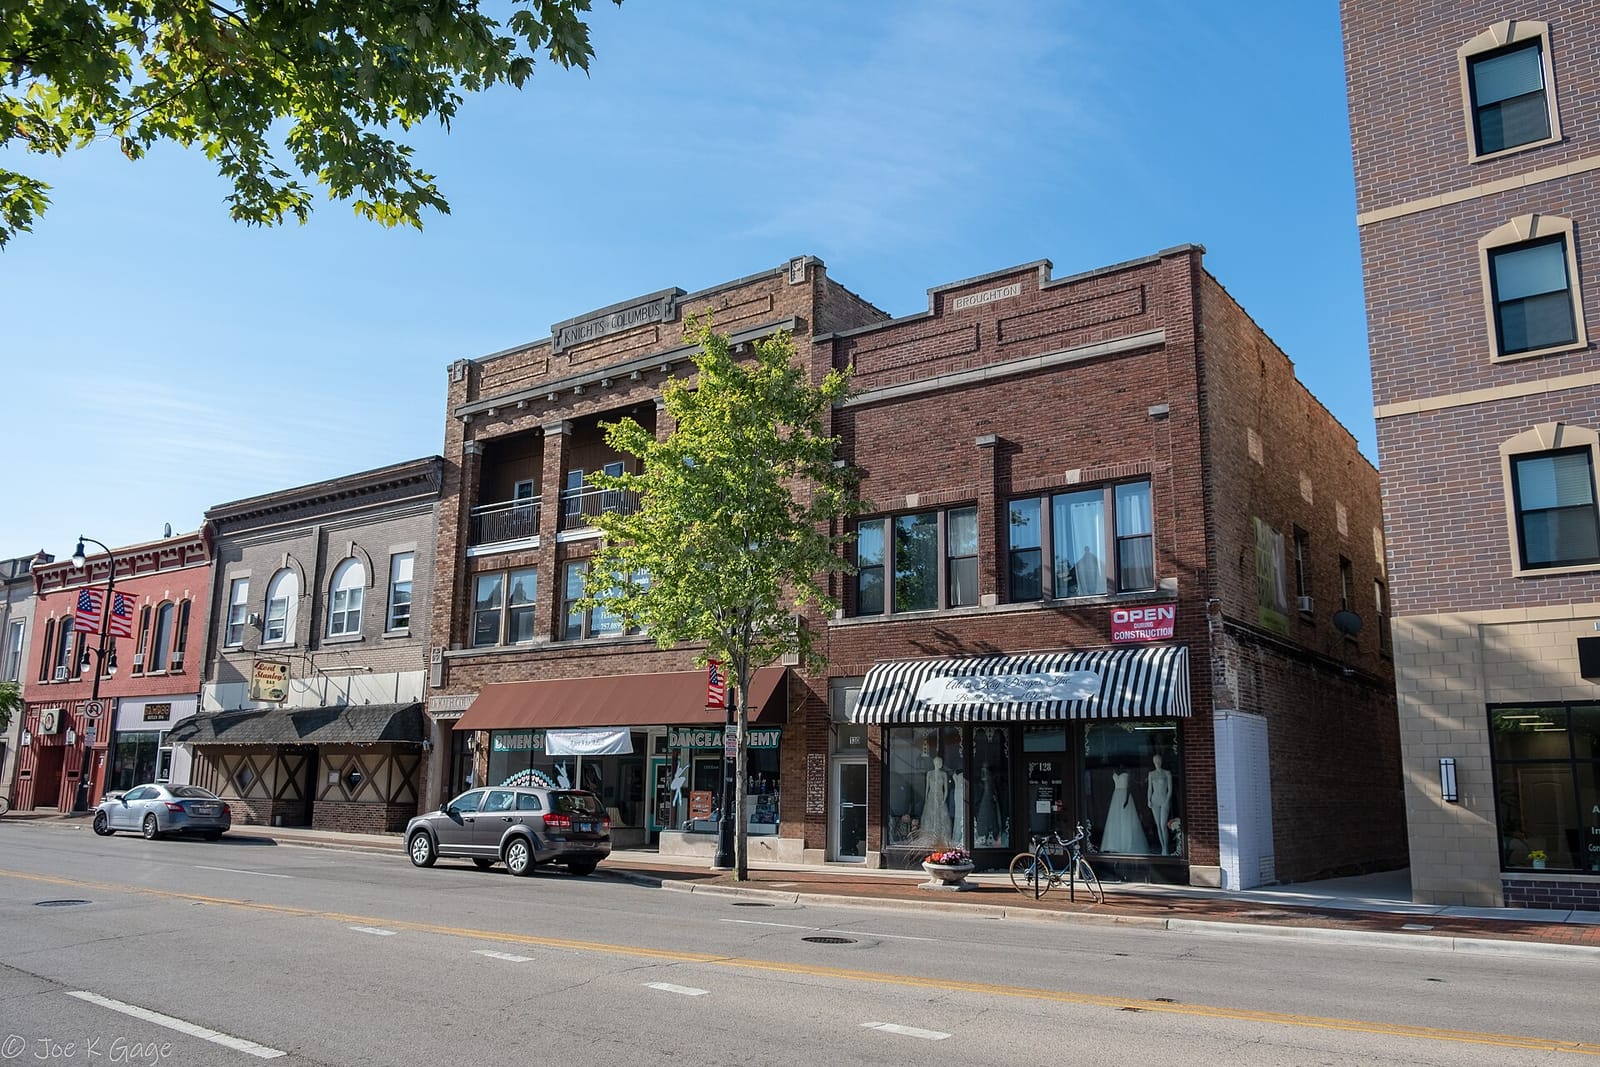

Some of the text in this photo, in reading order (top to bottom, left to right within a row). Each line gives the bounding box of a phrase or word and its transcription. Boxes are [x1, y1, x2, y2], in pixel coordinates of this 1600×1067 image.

[956, 286, 1017, 308] BROUGHTON
[564, 320, 605, 344] KNIGHTS
[611, 303, 661, 329] COLUMBUS
[1113, 606, 1174, 624] OPEN
[1114, 627, 1173, 640] CONSTRUCTION
[255, 671, 287, 681] Stanley's
[257, 663, 276, 672] Lord
[495, 734, 546, 749] DIMENSI
[669, 731, 711, 747] DANCE
